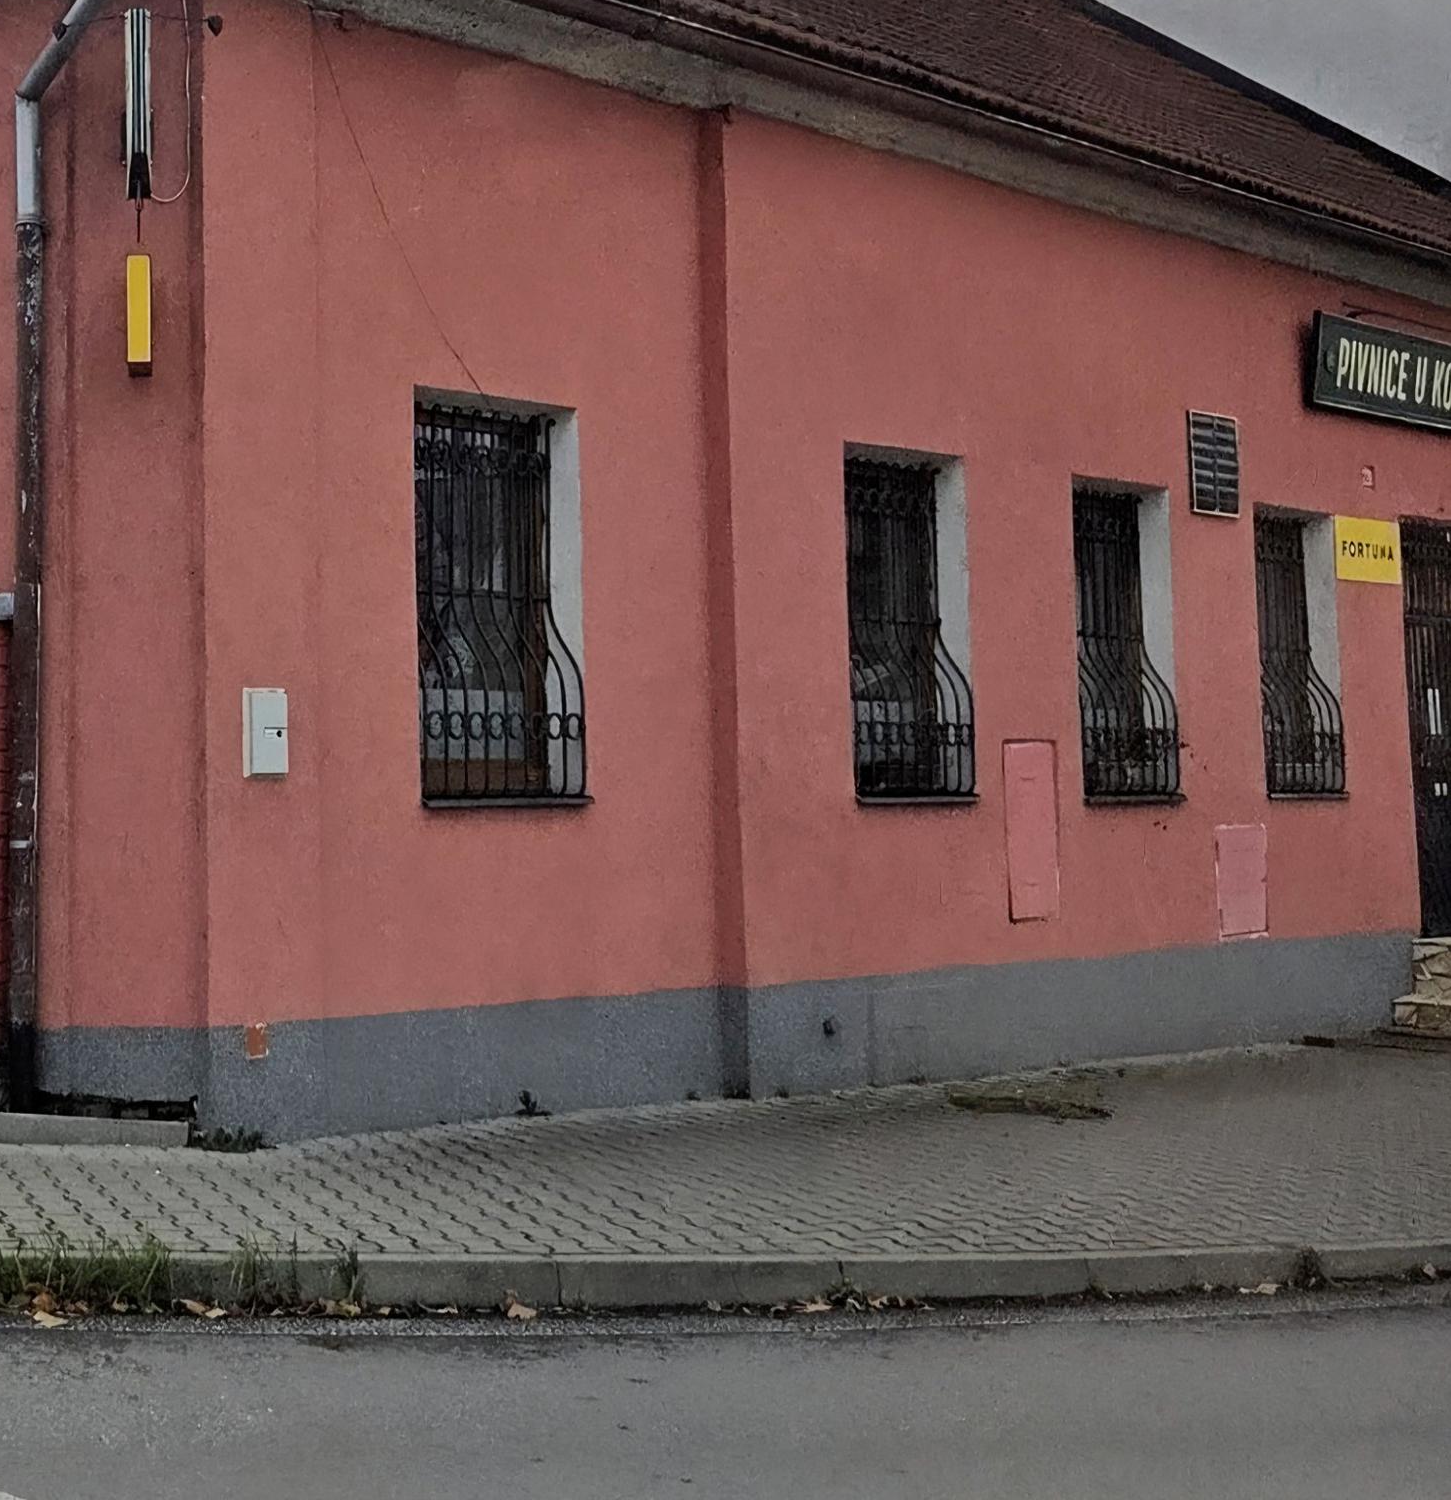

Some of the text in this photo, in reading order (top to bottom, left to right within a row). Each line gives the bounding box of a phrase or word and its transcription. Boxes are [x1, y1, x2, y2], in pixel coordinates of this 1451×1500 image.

[1336, 337, 1411, 401] PIVNICE
[1415, 356, 1428, 404] U
[1342, 540, 1394, 561] FORTUNA
